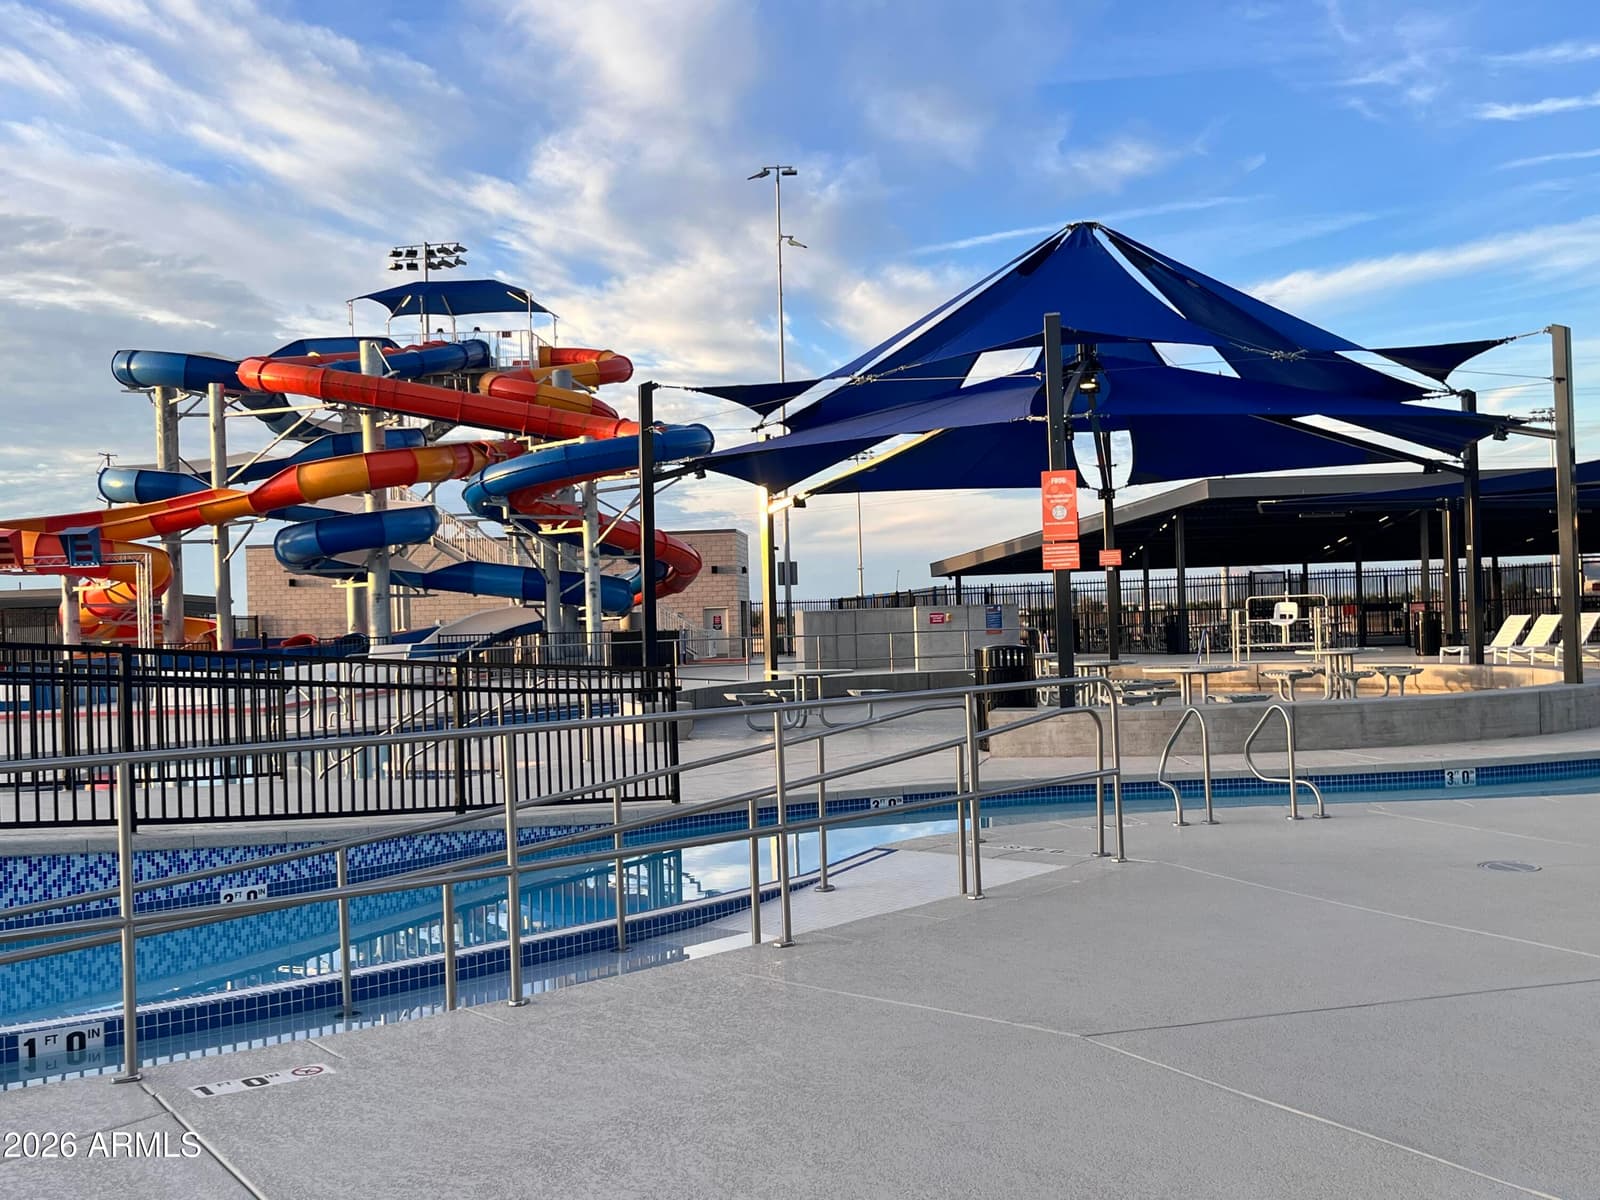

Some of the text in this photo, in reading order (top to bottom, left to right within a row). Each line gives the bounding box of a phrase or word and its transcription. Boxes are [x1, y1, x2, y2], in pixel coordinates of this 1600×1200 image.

[24, 1028, 100, 1058] 1 FT 0 IN
[193, 1086, 215, 1096] 1
[241, 1077, 270, 1087] 0
